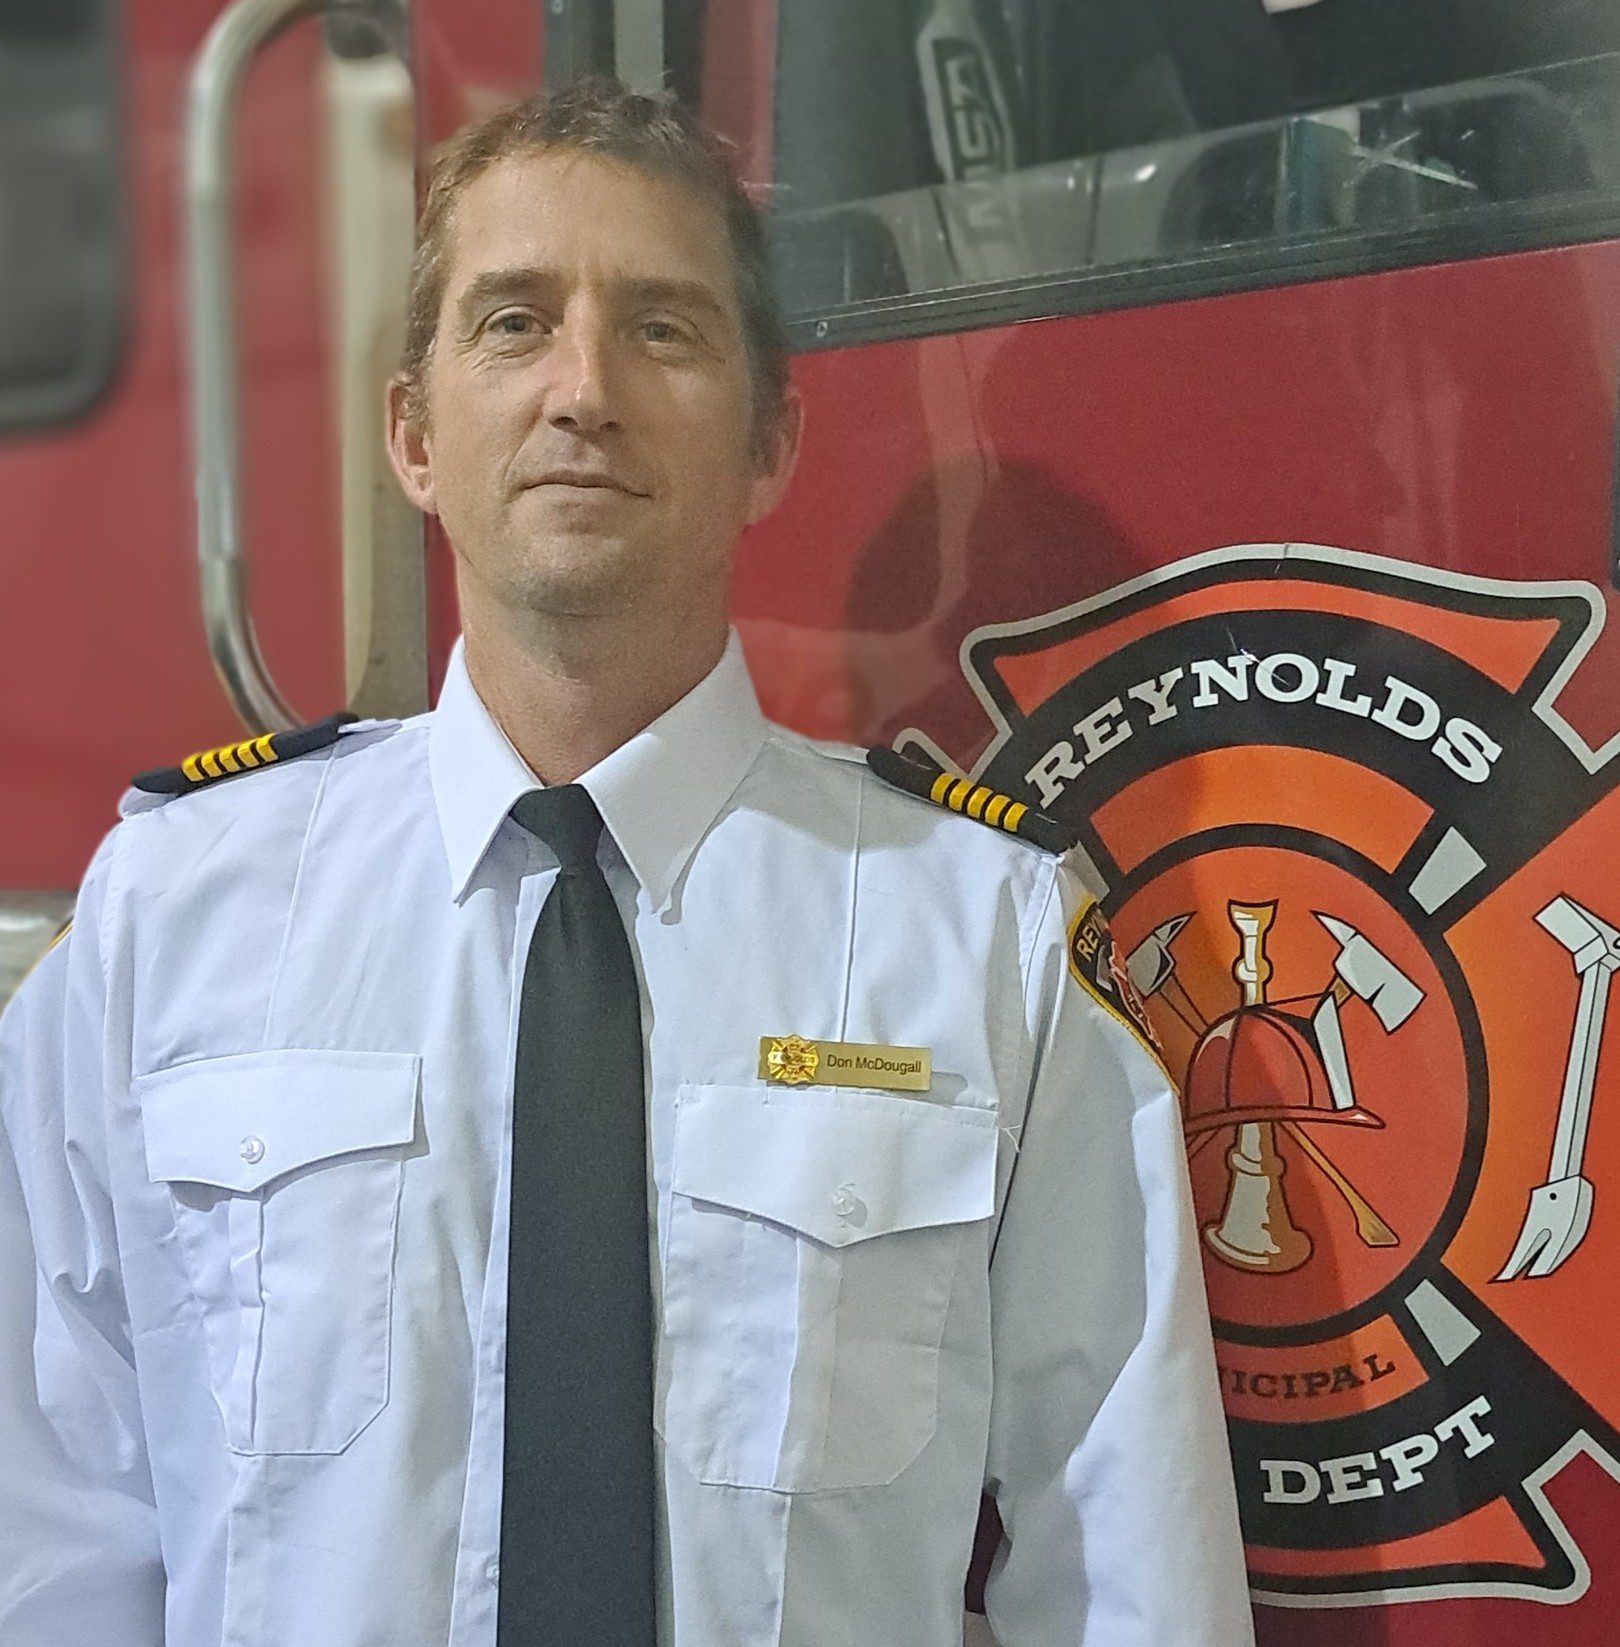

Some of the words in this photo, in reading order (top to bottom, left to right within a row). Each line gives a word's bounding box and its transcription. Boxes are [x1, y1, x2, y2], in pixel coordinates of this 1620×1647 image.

[1025, 653, 1503, 809] REYNOLDS
[827, 1055, 852, 1069] Don
[855, 1057, 922, 1075] McDougall
[1220, 1353, 1396, 1399] ICIPAL
[1260, 1395, 1495, 1504] DEPT
